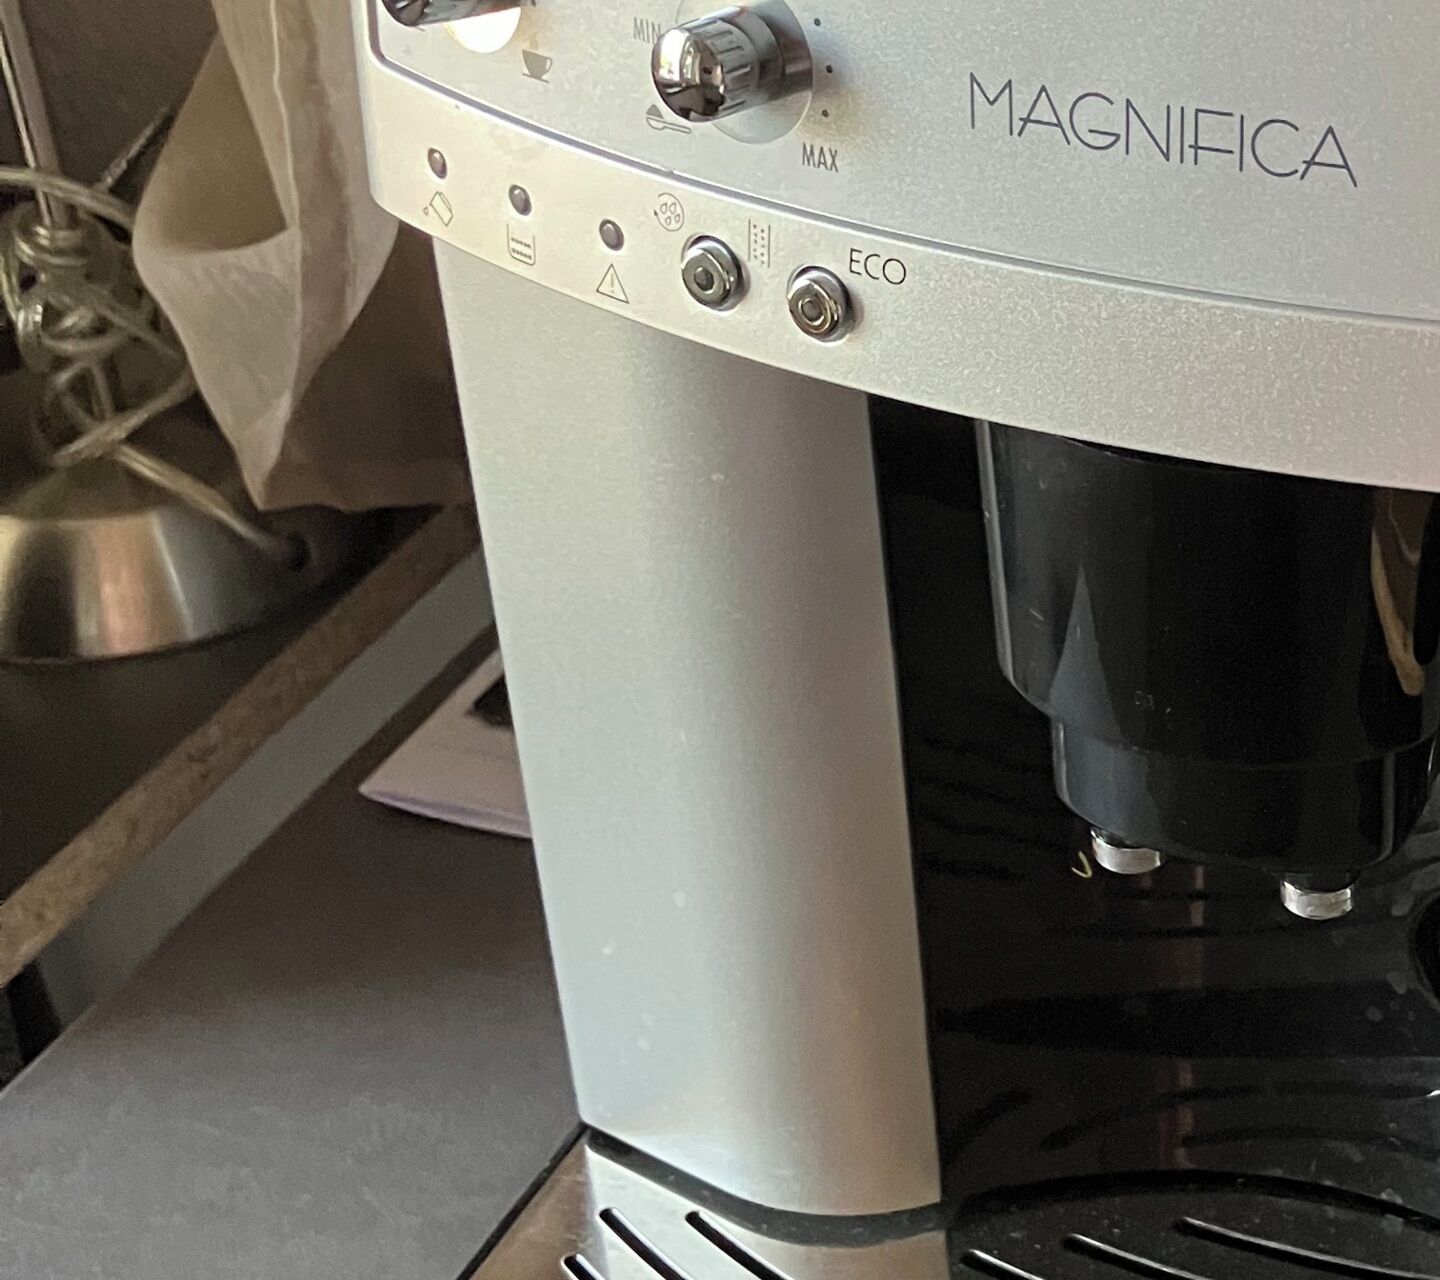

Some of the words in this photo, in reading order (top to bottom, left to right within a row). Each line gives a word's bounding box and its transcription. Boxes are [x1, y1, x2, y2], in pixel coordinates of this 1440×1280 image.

[633, 16, 661, 45] MIN
[969, 71, 1358, 188] MAGNIFICA
[801, 141, 839, 174] MAX
[848, 248, 908, 286] ECO
